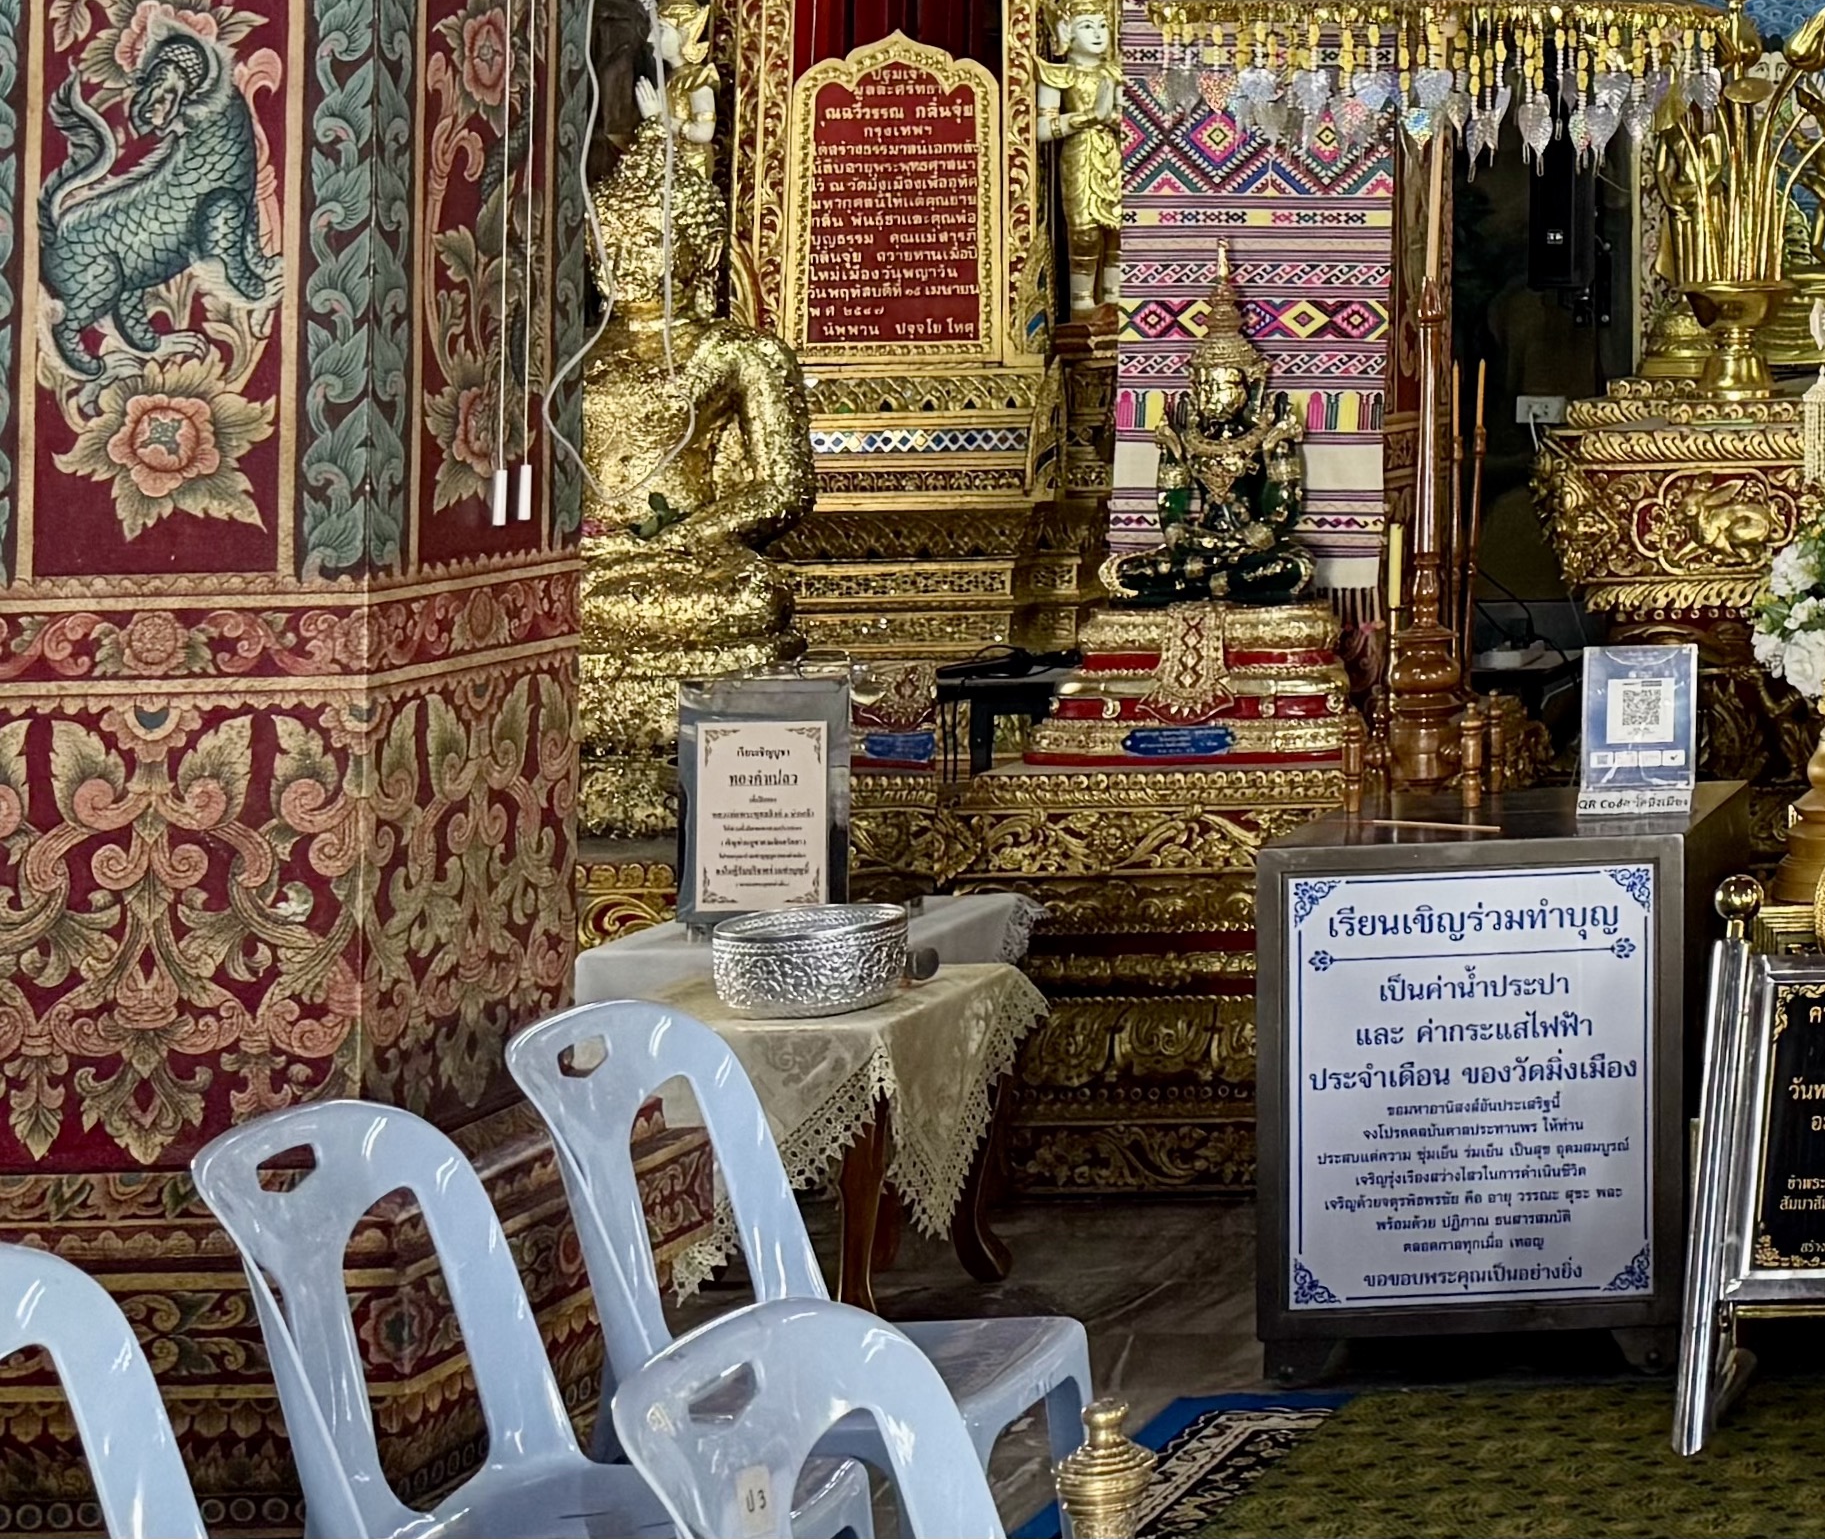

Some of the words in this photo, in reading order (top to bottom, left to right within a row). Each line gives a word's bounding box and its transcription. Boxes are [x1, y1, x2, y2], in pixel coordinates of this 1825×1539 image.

[864, 125, 932, 142] กรุงเทพฯ
[830, 181, 844, 191] ณ
[1328, 897, 1619, 942] เรียนเชิญร่วมทำบุญ
[1379, 964, 1570, 1002] เป็นค่าน้ำประปา
[1356, 1026, 1405, 1047] และ
[1416, 1009, 1593, 1044] ค่ากระแสไฟฟ้า
[1308, 1060, 1451, 1091] ประจำเดือน
[1461, 1047, 1637, 1085] ของวัดมิ่งเมือง
[1363, 1256, 1583, 1290] ขอขอบพระคุณเป็นอย่างยิ่ง
